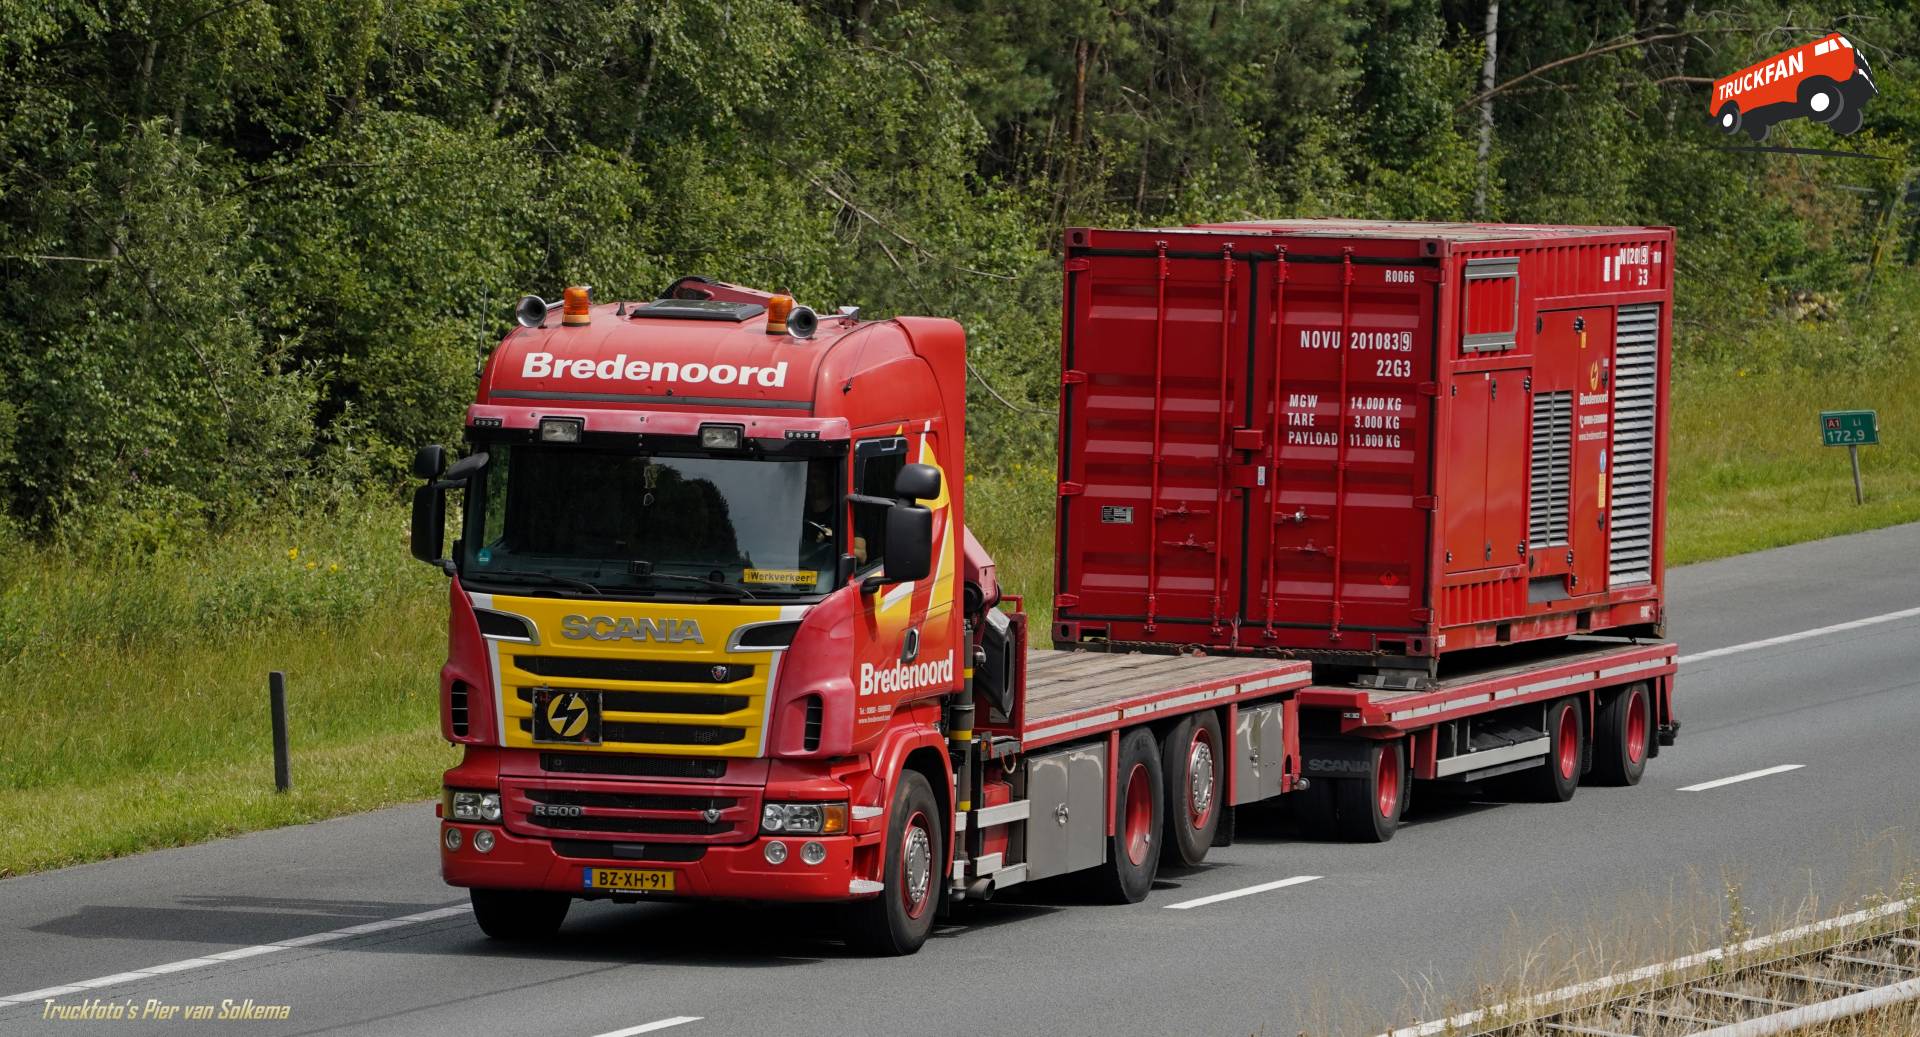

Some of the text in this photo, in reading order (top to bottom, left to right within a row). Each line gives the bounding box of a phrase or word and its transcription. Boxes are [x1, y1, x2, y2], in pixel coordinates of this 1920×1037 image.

[1385, 269, 1415, 283] R0066
[1300, 330, 1412, 351] NOVU 2010839
[521, 352, 788, 388] Bredenoord
[1376, 359, 1411, 377] 22G3
[1289, 394, 1402, 411] MGW 14.000 KG
[1287, 412, 1400, 430] TARE 3.000 KG
[1828, 418, 1840, 428] A1
[1288, 431, 1401, 448] PAYLOAD 11.000 KG
[750, 571, 811, 583] Werkverkeer
[560, 613, 705, 645] SCANIA
[859, 648, 954, 696] Bredenoord
[1308, 758, 1370, 773] SCANIA
[535, 805, 580, 817] R 500
[599, 871, 667, 888] BZ-XH-91
